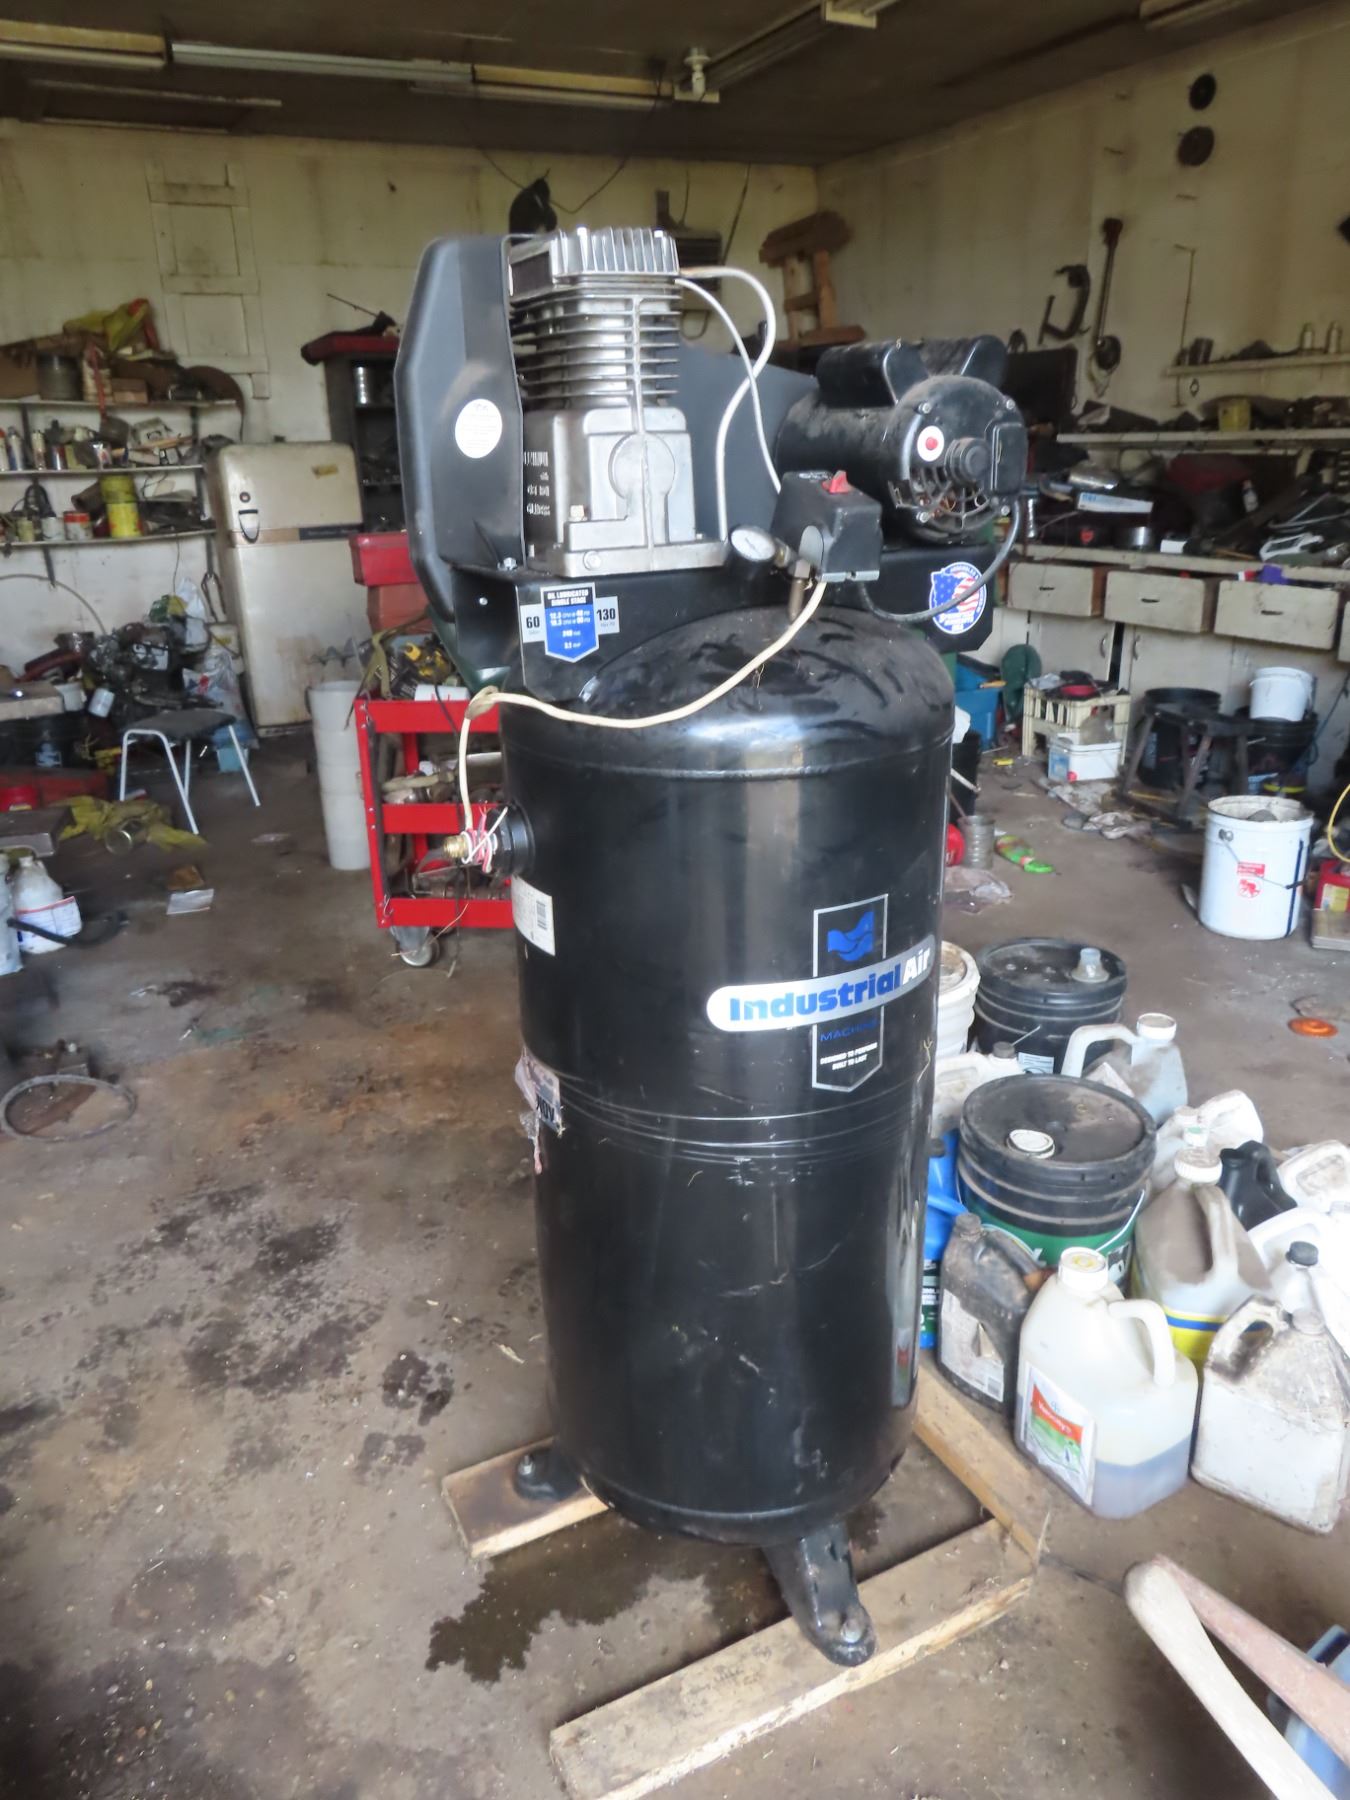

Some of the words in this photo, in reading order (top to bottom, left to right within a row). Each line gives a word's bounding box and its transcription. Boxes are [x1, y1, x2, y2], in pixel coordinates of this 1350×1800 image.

[596, 608, 616, 621] 130
[525, 616, 540, 629] 60
[847, 1050, 855, 1058] TO
[847, 1058, 855, 1066] TO
